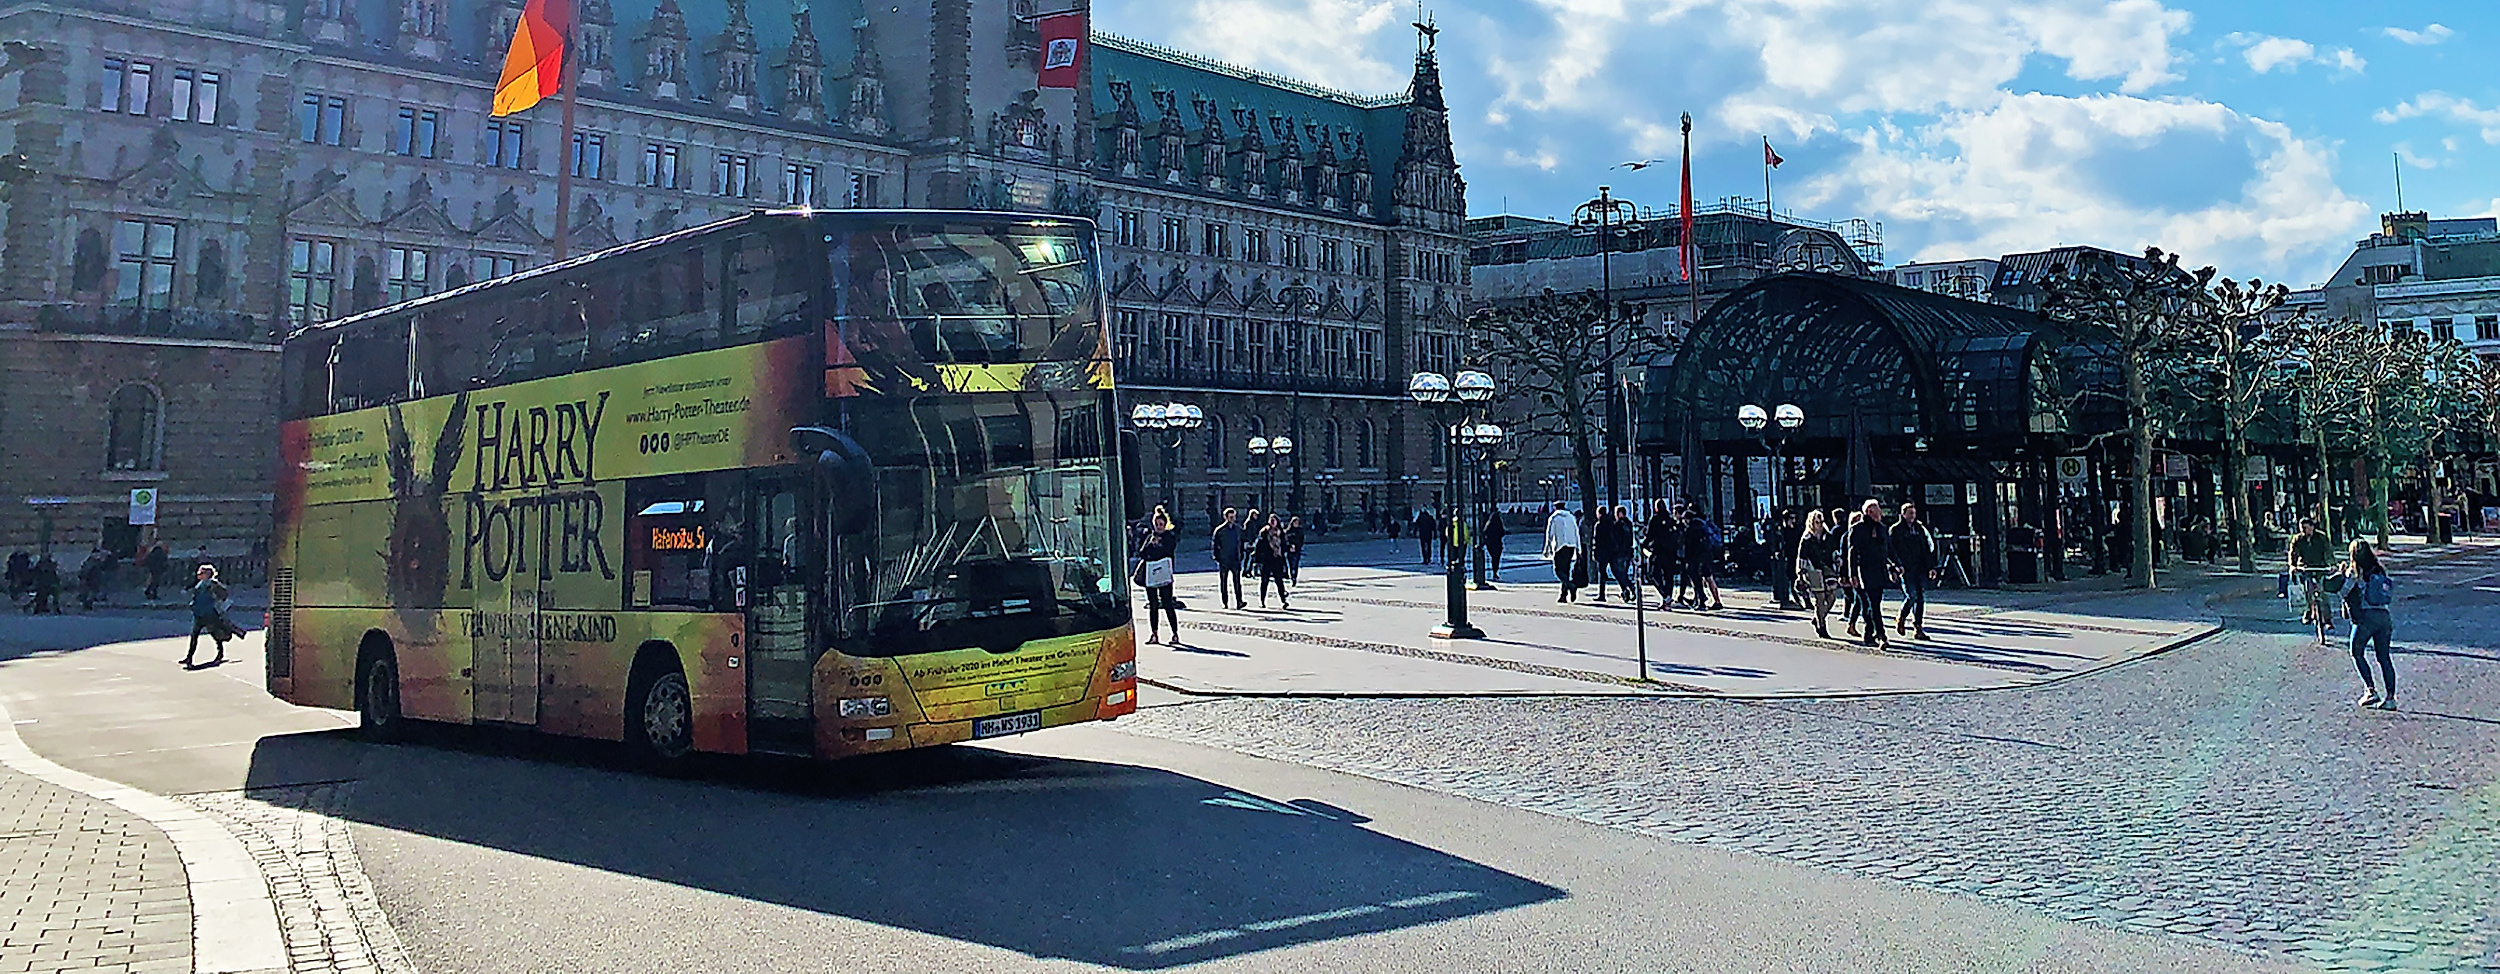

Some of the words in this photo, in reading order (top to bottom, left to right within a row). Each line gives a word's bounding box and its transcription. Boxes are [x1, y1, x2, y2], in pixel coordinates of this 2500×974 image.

[472, 390, 611, 492] HARRY
[460, 489, 616, 590] POTTER
[573, 613, 617, 643] KIND
[961, 661, 980, 673] 2020
[1015, 655, 1044, 665] Theater
[981, 721, 995, 735] HH
[1001, 718, 1014, 731] WS
[1015, 714, 1038, 730] 1931
